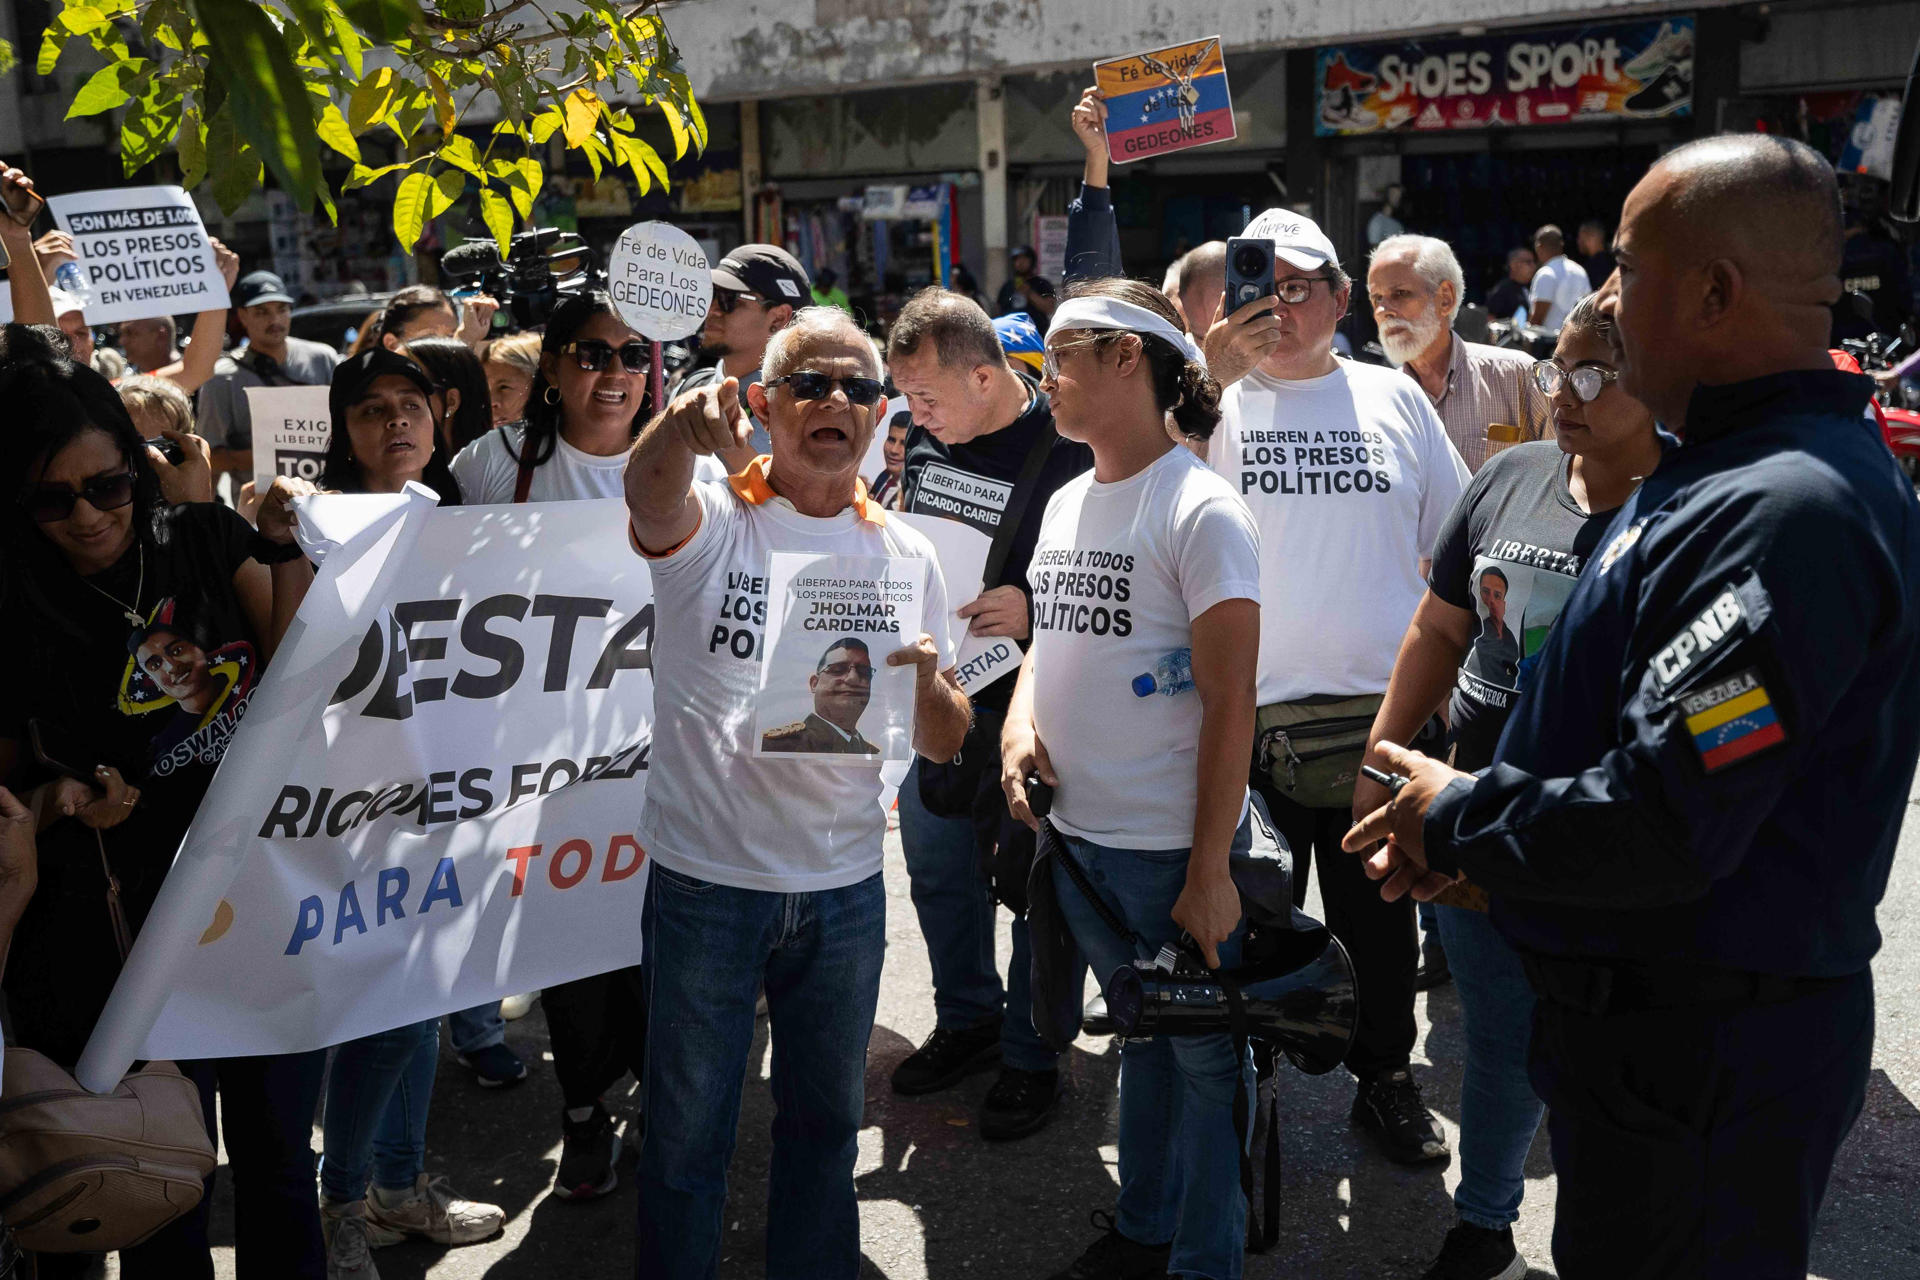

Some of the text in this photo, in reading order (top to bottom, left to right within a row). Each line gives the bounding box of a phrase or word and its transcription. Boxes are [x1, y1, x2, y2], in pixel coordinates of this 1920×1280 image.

[1120, 63, 1139, 81] Fé
[1166, 53, 1198, 72] vida
[1380, 52, 1491, 102] SHOES
[1143, 99, 1161, 113] de
[1125, 121, 1219, 153] GEDEONES.
[70, 214, 106, 232] SON
[108, 210, 141, 229] MÁS
[143, 211, 165, 226] DE
[82, 232, 201, 259] LOS PRESOS
[647, 243, 666, 261] de
[672, 247, 706, 270] Vida
[88, 255, 205, 284] POLÍTICOS
[627, 262, 698, 291] Para Los
[101, 281, 208, 304] EN VENEZUELA
[613, 280, 706, 318] GEDEONES
[1240, 430, 1382, 444] LIBEREN A TODOS
[1242, 447, 1385, 466] LOS PRESOS
[925, 471, 1004, 504] LIBERTAD PARA
[1241, 466, 1391, 495] POLÍTICOS
[917, 490, 961, 514] RICARDO
[1075, 551, 1083, 567] A
[1087, 551, 1134, 573] TODOS
[796, 578, 913, 590] LIBERTAD PARA TODOS
[797, 591, 817, 599] LOS
[820, 591, 859, 600] PRESOS
[1055, 571, 1130, 602] PRESOS
[720, 594, 768, 625] LOS
[809, 602, 896, 617] JHOLMAR
[803, 618, 900, 633] CARDENAS
[1655, 592, 1740, 684] CPNB
[1681, 673, 1759, 714] VENEZUELA
[284, 857, 464, 955] PARA
